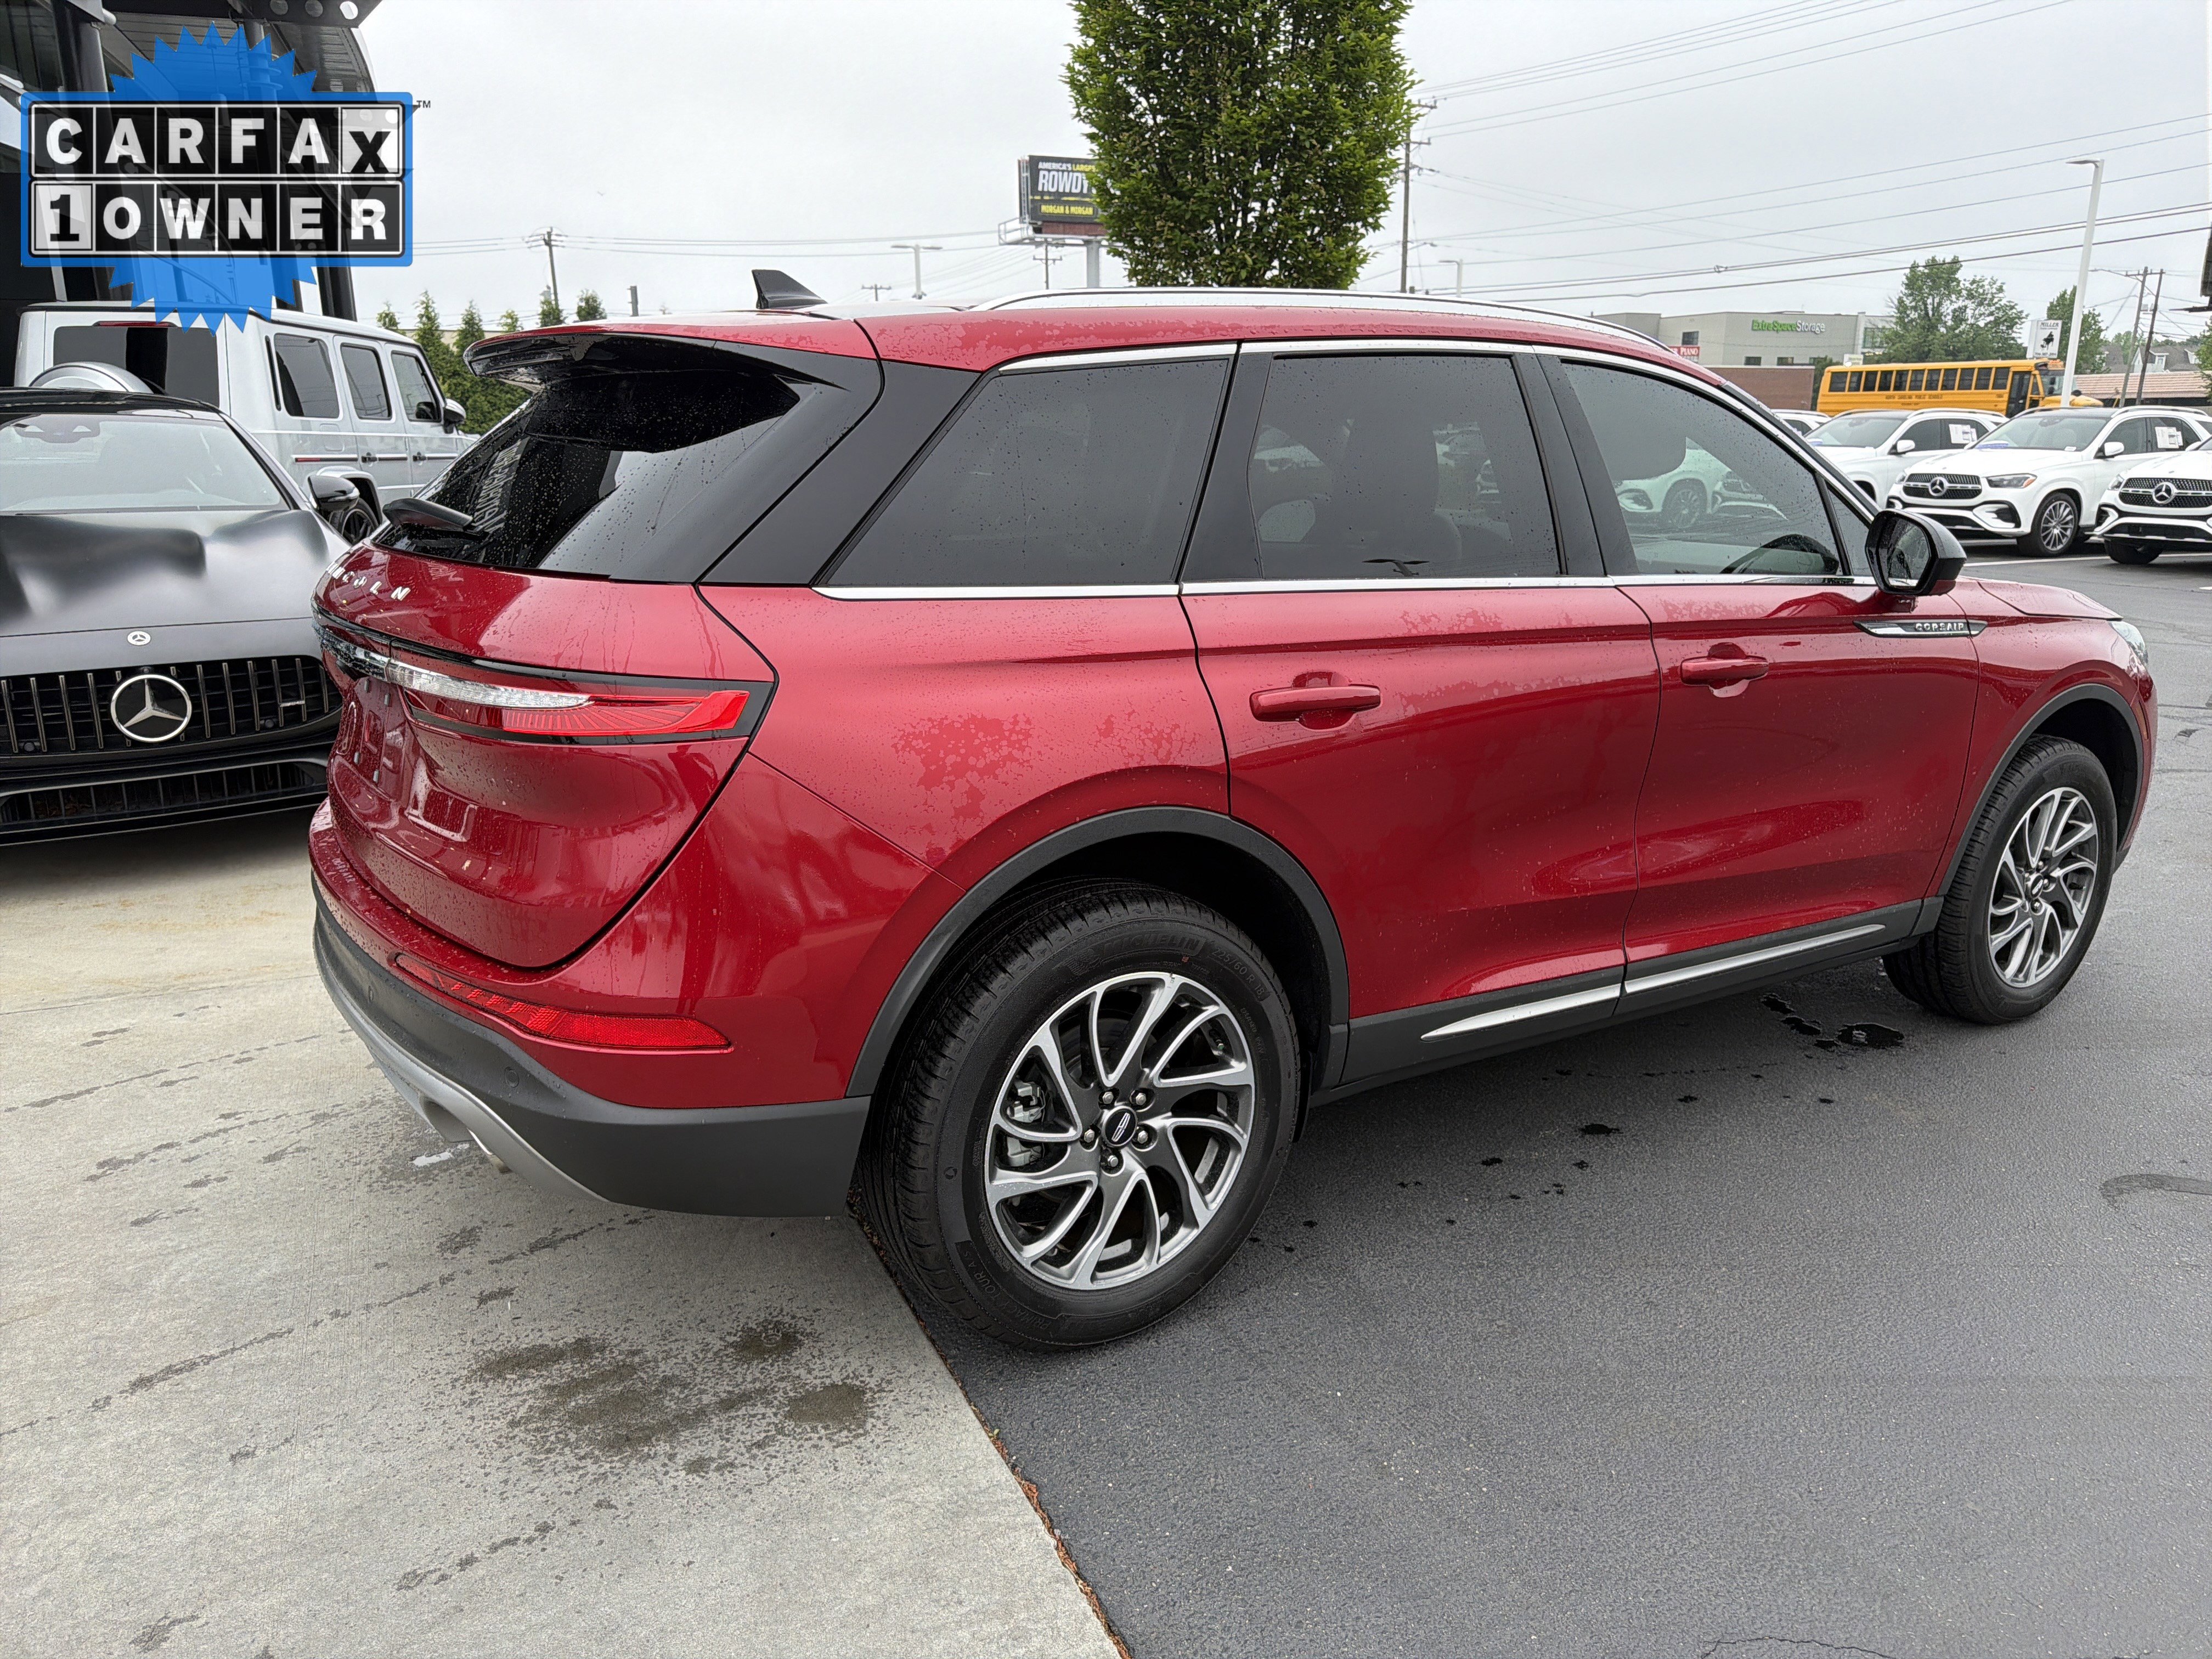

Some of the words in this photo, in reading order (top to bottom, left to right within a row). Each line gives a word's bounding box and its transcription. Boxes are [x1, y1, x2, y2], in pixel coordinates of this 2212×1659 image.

[1038, 162, 1071, 171] AMERICA'S
[1041, 205, 1064, 213] MORGAN
[1070, 206, 1093, 215] MORGAN
[1680, 347, 1699, 356] PIANO
[1915, 623, 1964, 631] CORSAIR
[1102, 933, 1201, 957] MICHELIN
